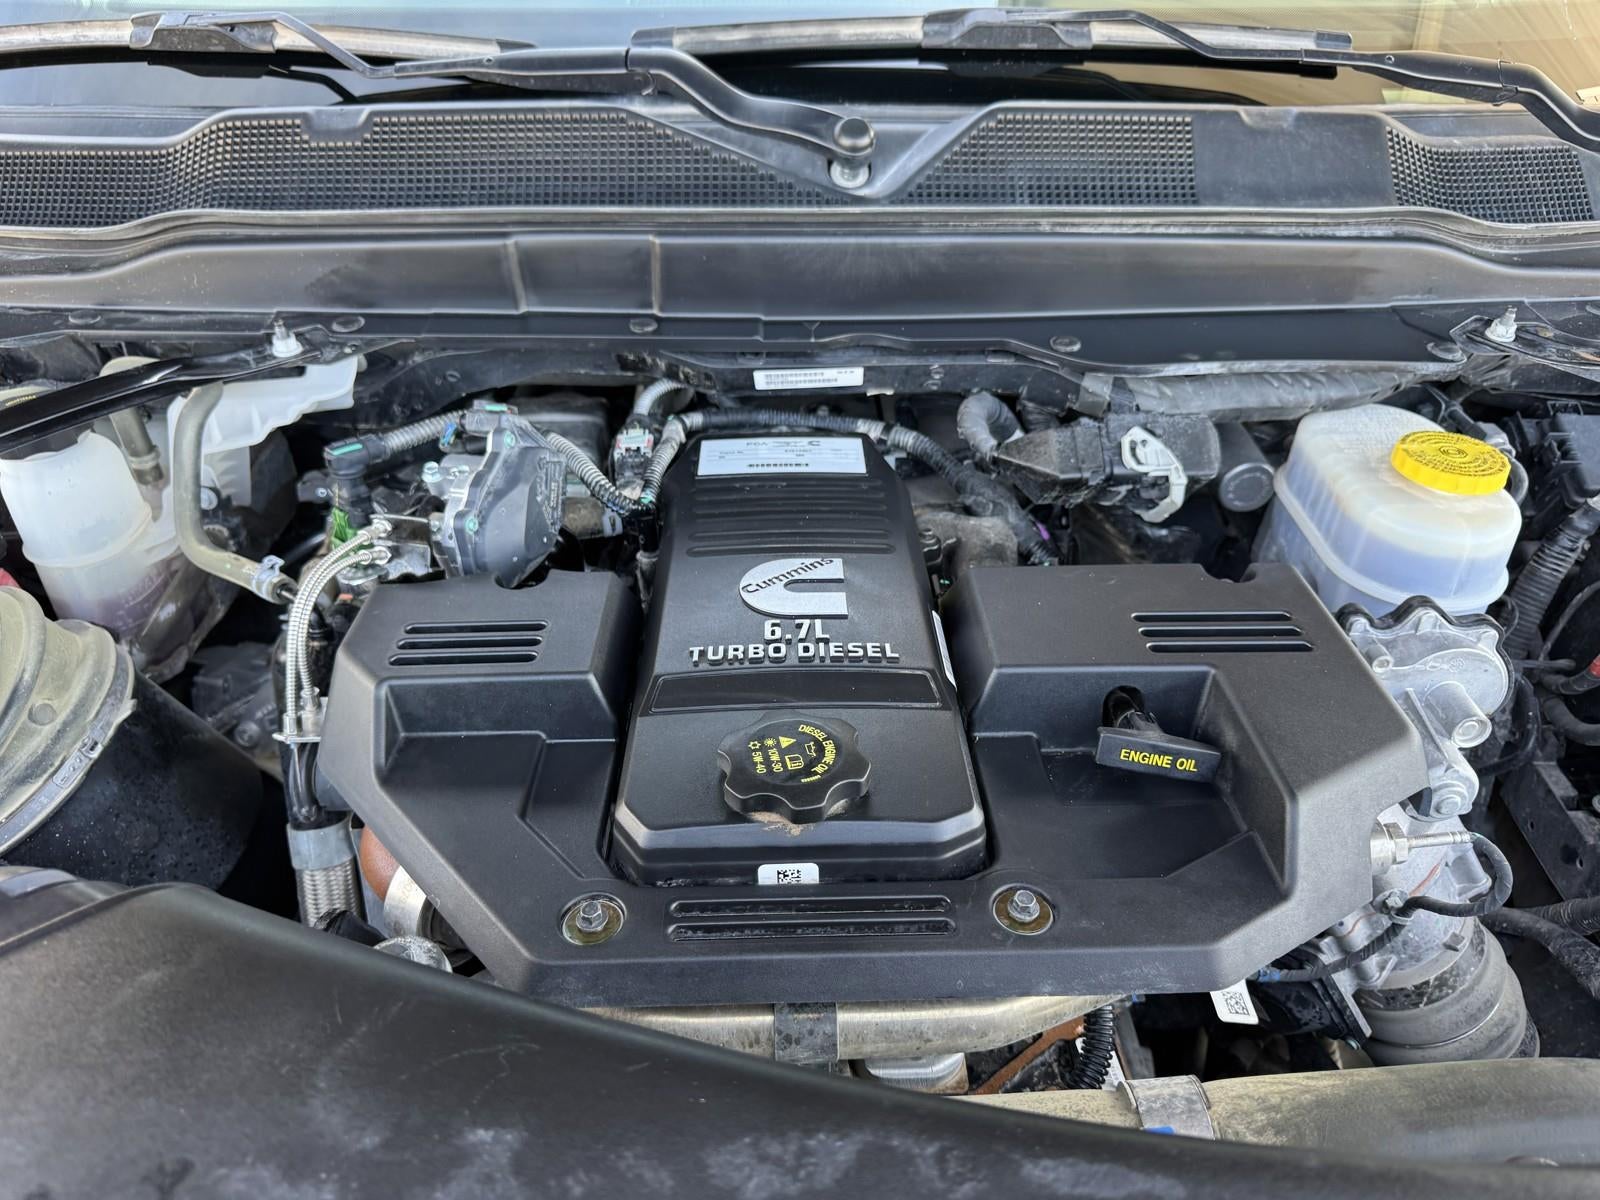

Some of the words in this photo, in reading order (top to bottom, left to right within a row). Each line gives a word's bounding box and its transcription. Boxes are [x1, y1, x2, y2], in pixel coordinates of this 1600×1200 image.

[741, 557, 834, 594] Cummins
[763, 619, 830, 643] 6.7L
[689, 643, 787, 665] TURBO
[797, 642, 900, 664] DIESEL
[798, 724, 827, 741] DIESEL
[752, 751, 767, 774] 5W-40
[822, 740, 836, 765] ENGINE
[1120, 749, 1173, 768] ENGINE
[1175, 758, 1198, 772] OIL
[811, 764, 828, 775] OIL
